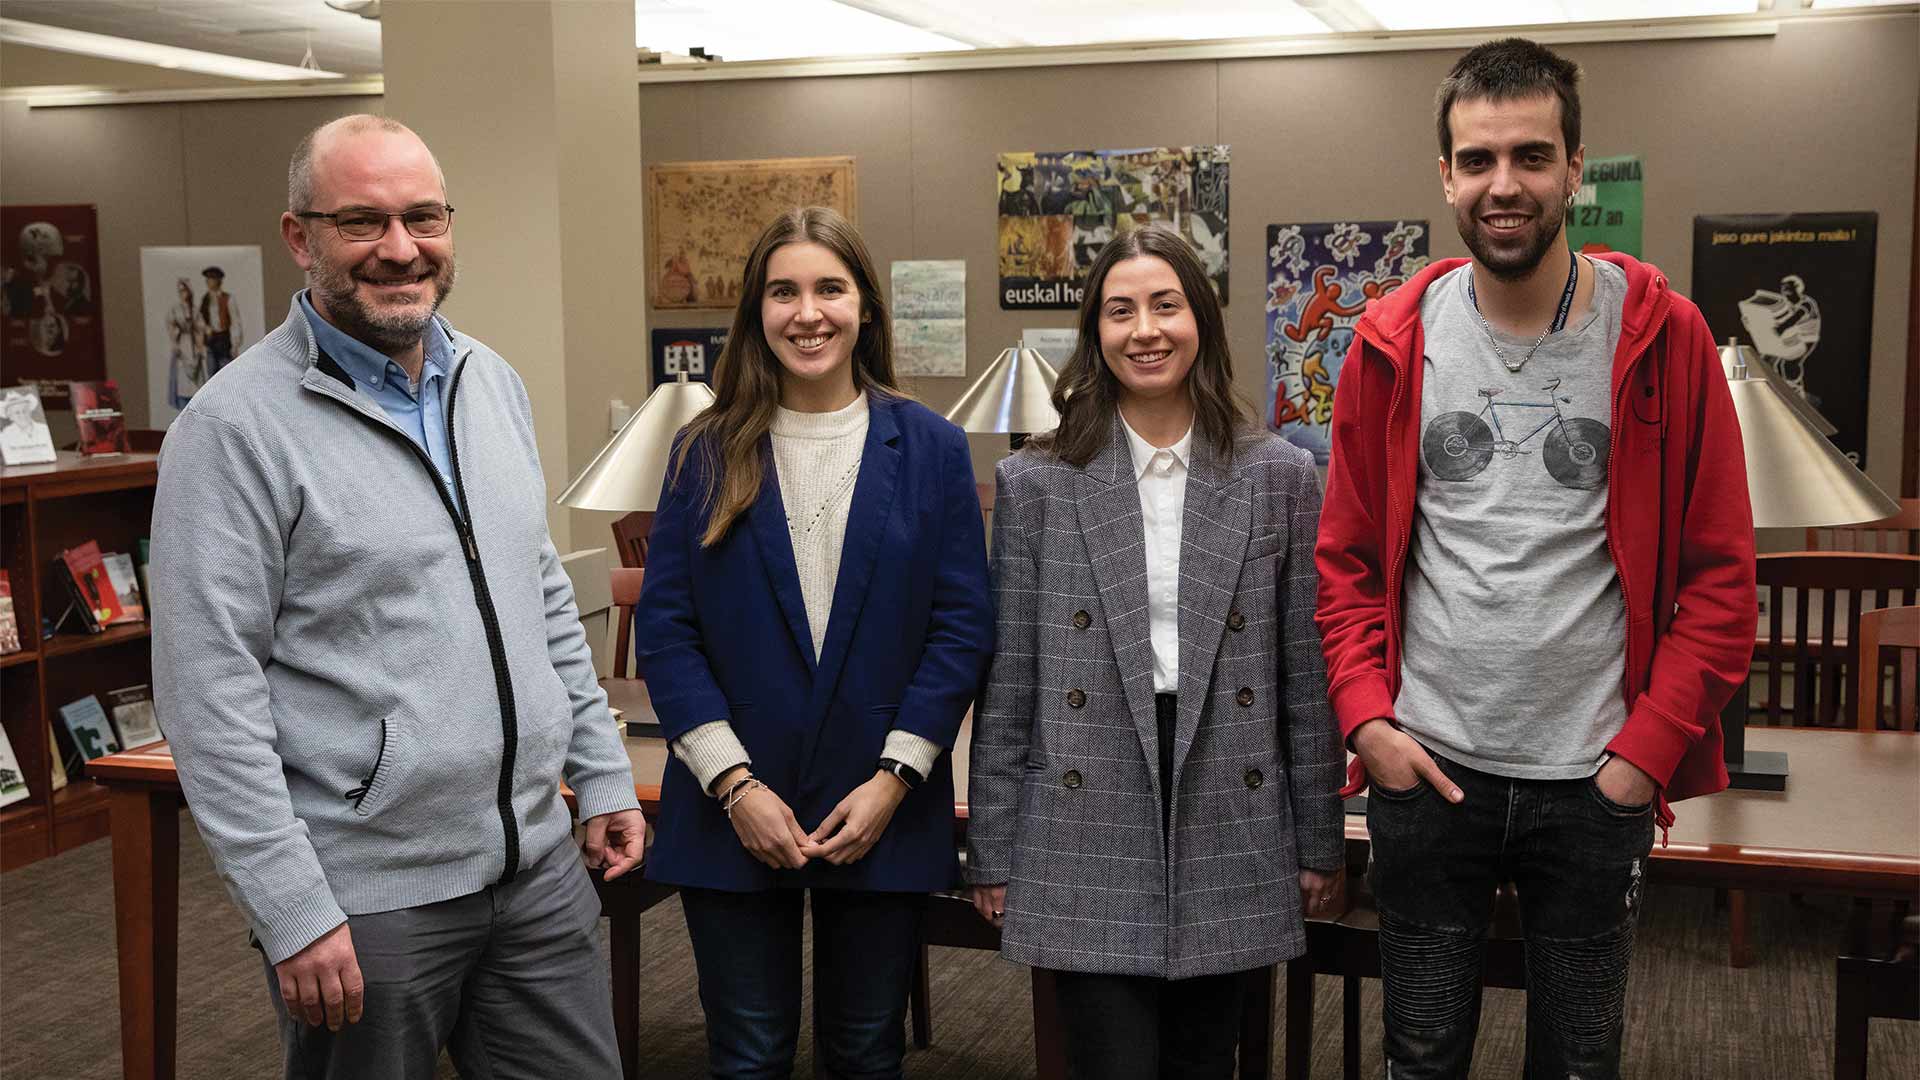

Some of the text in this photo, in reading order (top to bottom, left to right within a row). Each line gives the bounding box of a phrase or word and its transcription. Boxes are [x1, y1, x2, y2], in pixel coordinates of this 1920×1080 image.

[1589, 160, 1642, 183] EGUNA
[1580, 206, 1603, 226] 27
[1607, 210, 1624, 226] an
[1005, 282, 1060, 303] euskal
